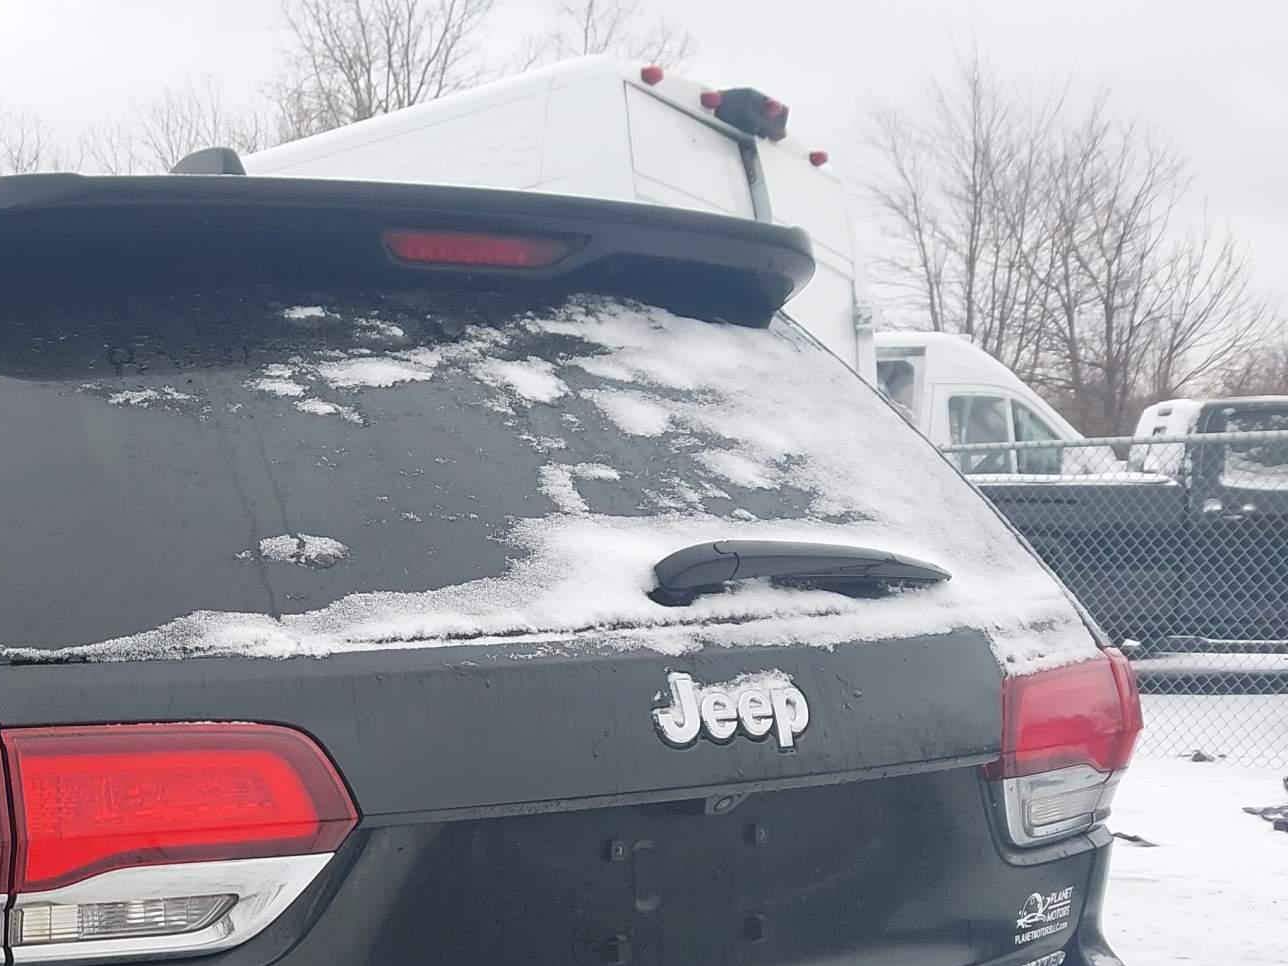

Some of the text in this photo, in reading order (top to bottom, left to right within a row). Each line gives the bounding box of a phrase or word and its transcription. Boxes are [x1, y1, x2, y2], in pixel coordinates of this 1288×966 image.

[652, 671, 810, 747] Jeep
[1049, 886, 1074, 904] PLANET
[1046, 905, 1070, 922] MOTORS
